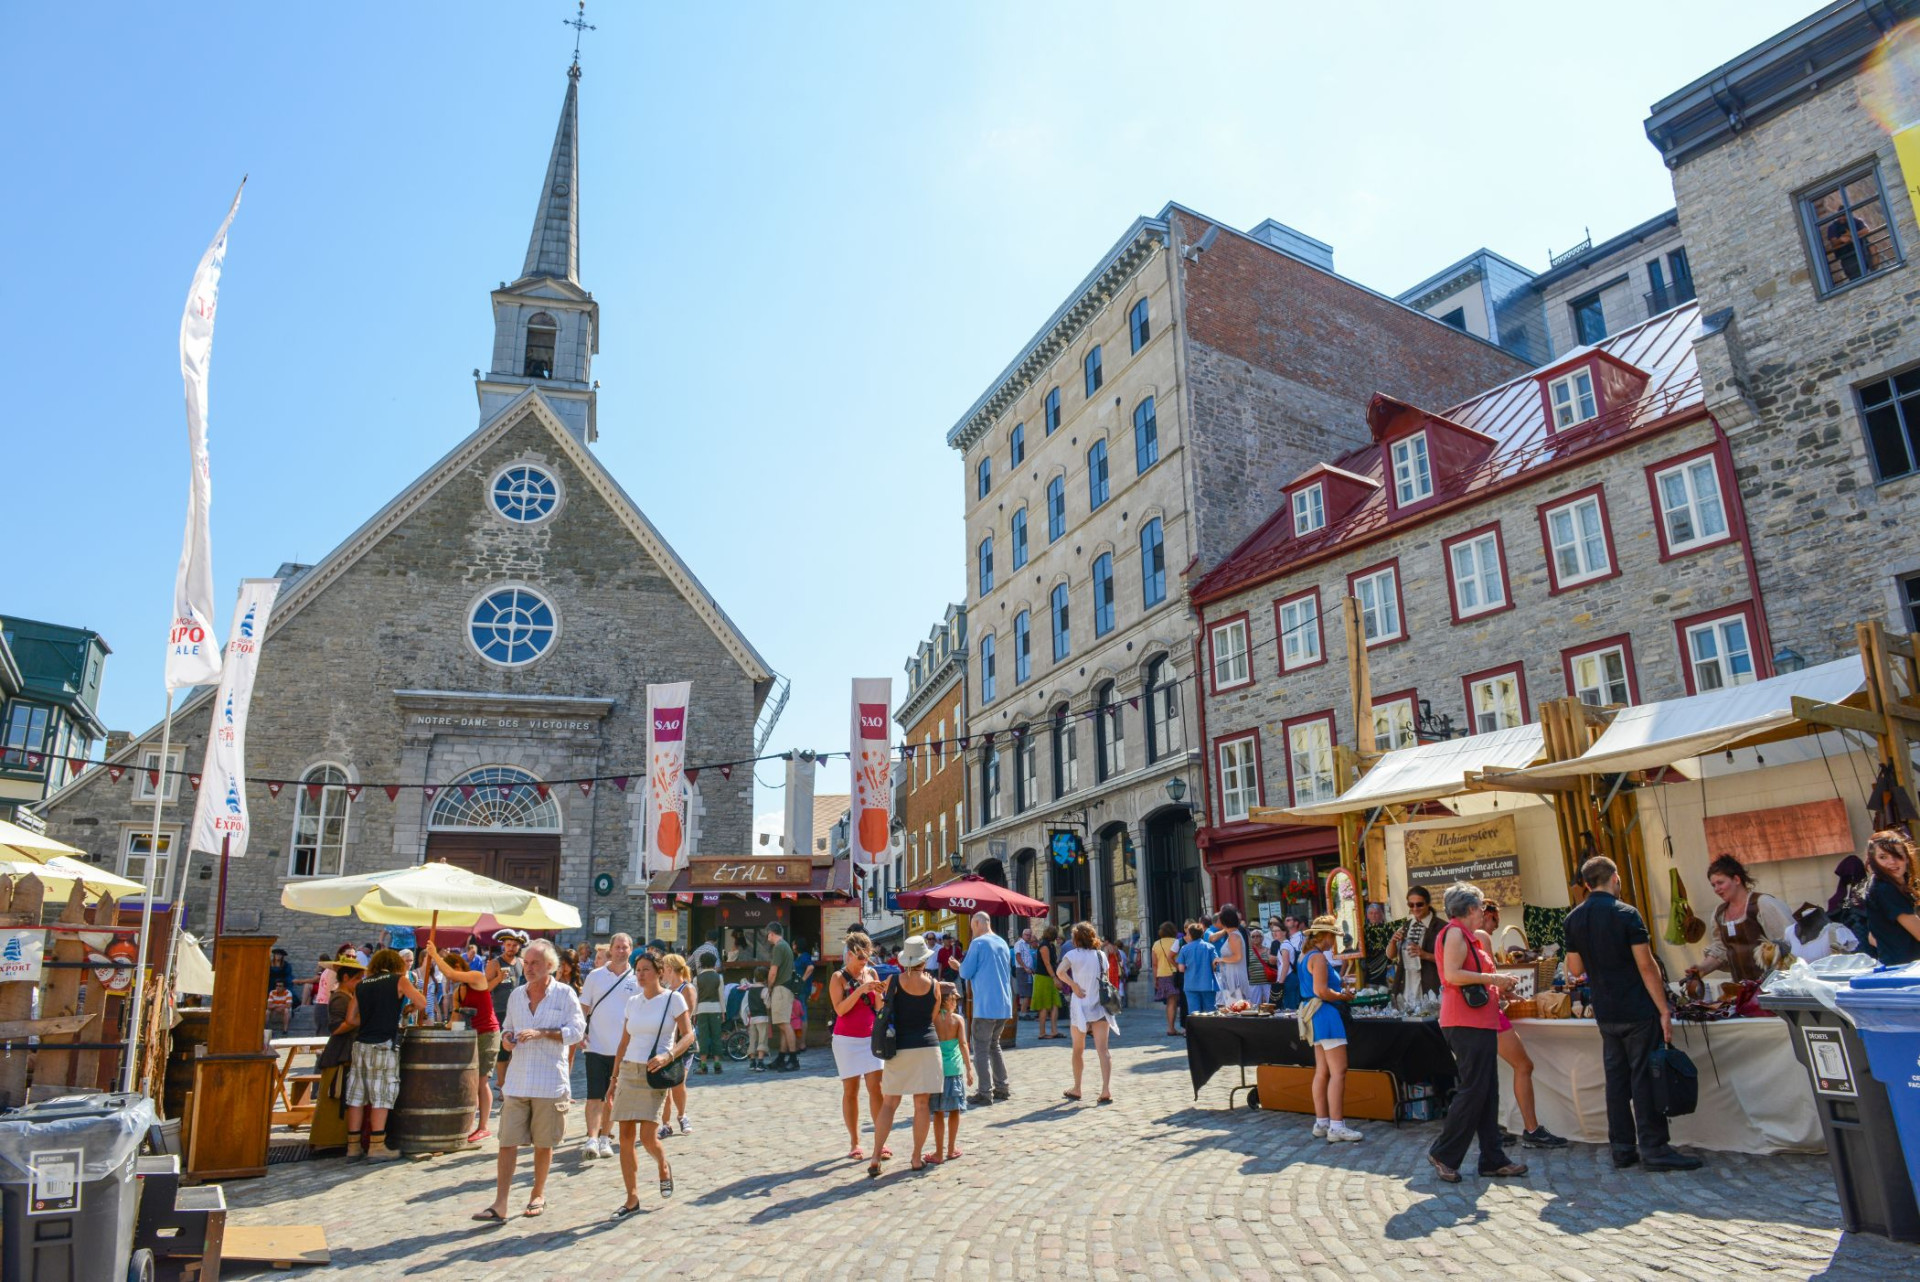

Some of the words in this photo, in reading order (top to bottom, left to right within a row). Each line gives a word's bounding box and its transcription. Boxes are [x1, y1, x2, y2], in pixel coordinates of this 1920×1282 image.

[176, 645, 200, 655] ALE
[417, 716, 488, 727] NOTRE-DAME
[498, 720, 519, 728] DES
[529, 720, 590, 730] VICTOIRES
[654, 719, 680, 731] SAQ
[861, 716, 883, 728] SAQ
[713, 863, 768, 882] ÉTAL
[949, 897, 977, 909] SAQ
[744, 910, 761, 918] SAQ
[37, 1155, 64, 1163] DÉCHETS
